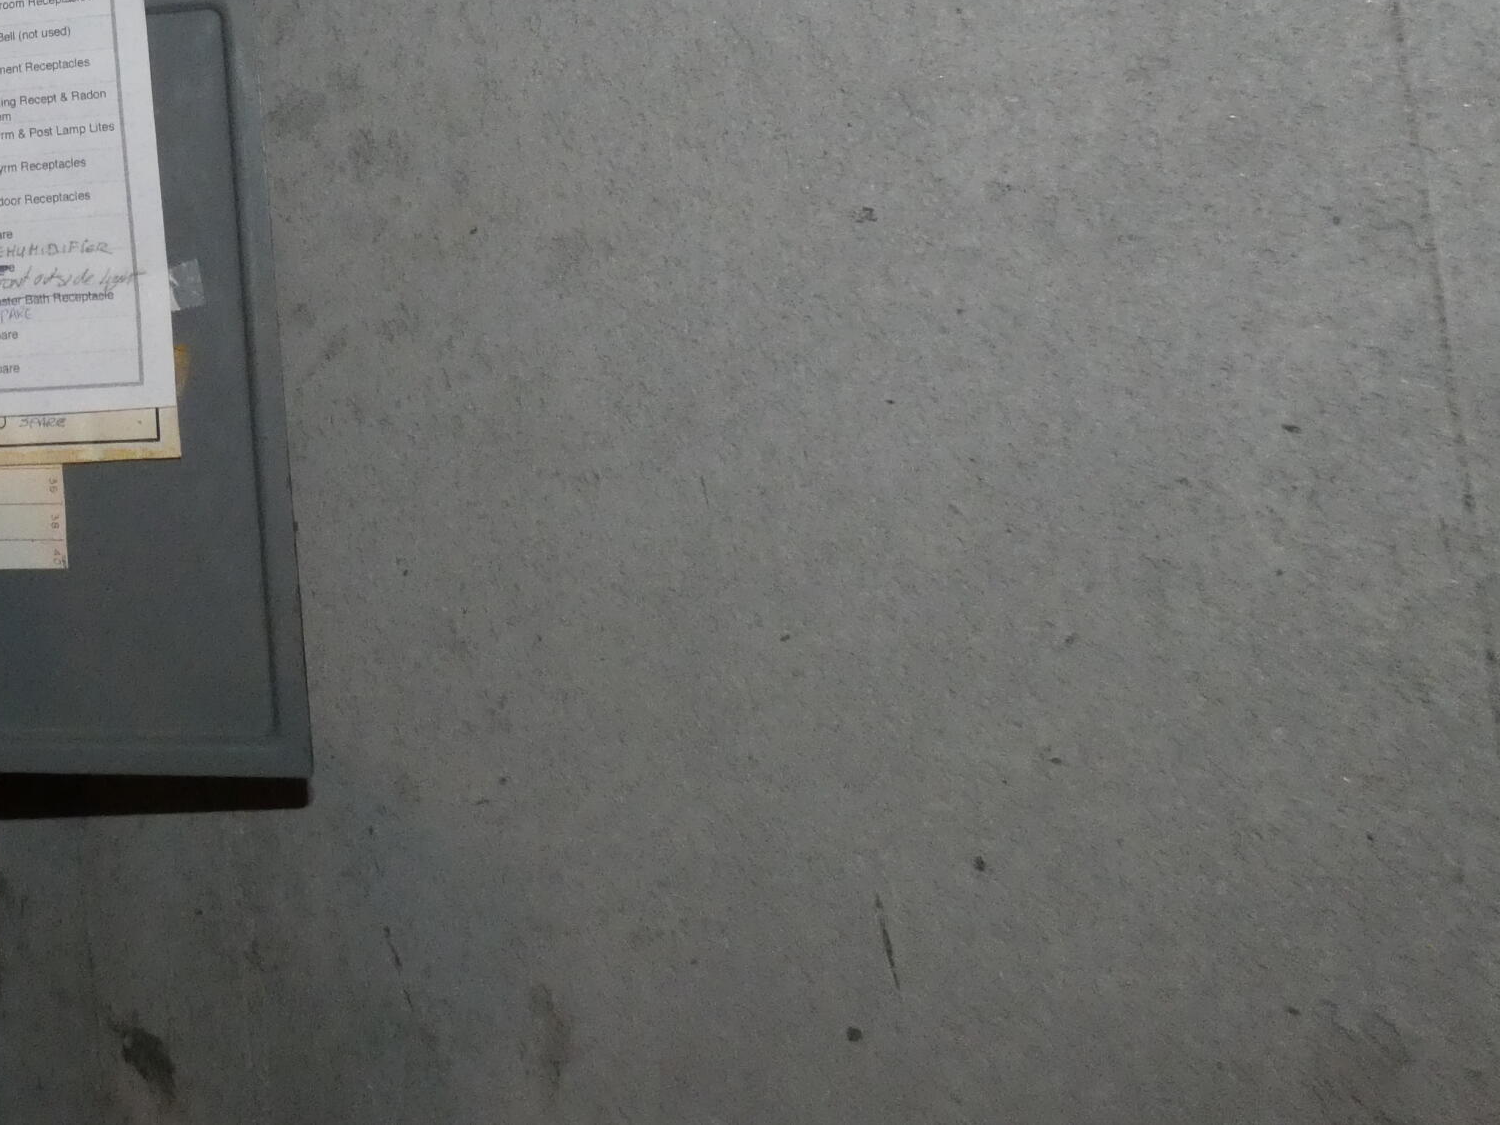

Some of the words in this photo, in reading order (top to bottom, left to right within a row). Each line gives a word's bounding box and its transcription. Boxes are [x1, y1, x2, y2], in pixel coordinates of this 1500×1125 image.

[19, 29, 38, 41] (not
[42, 26, 71, 39] used)
[25, 58, 90, 73] Receptacles
[20, 94, 57, 106] Recept
[60, 92, 68, 102] &
[72, 89, 106, 101] Radon
[18, 128, 26, 138] &
[29, 126, 53, 138] Post
[56, 123, 86, 136] Lamp
[90, 122, 115, 132] Lites
[21, 157, 86, 172] Receptacles
[24, 191, 91, 205] Receptacles
[25, 294, 49, 305] Bath
[53, 290, 114, 304] Receptacle
